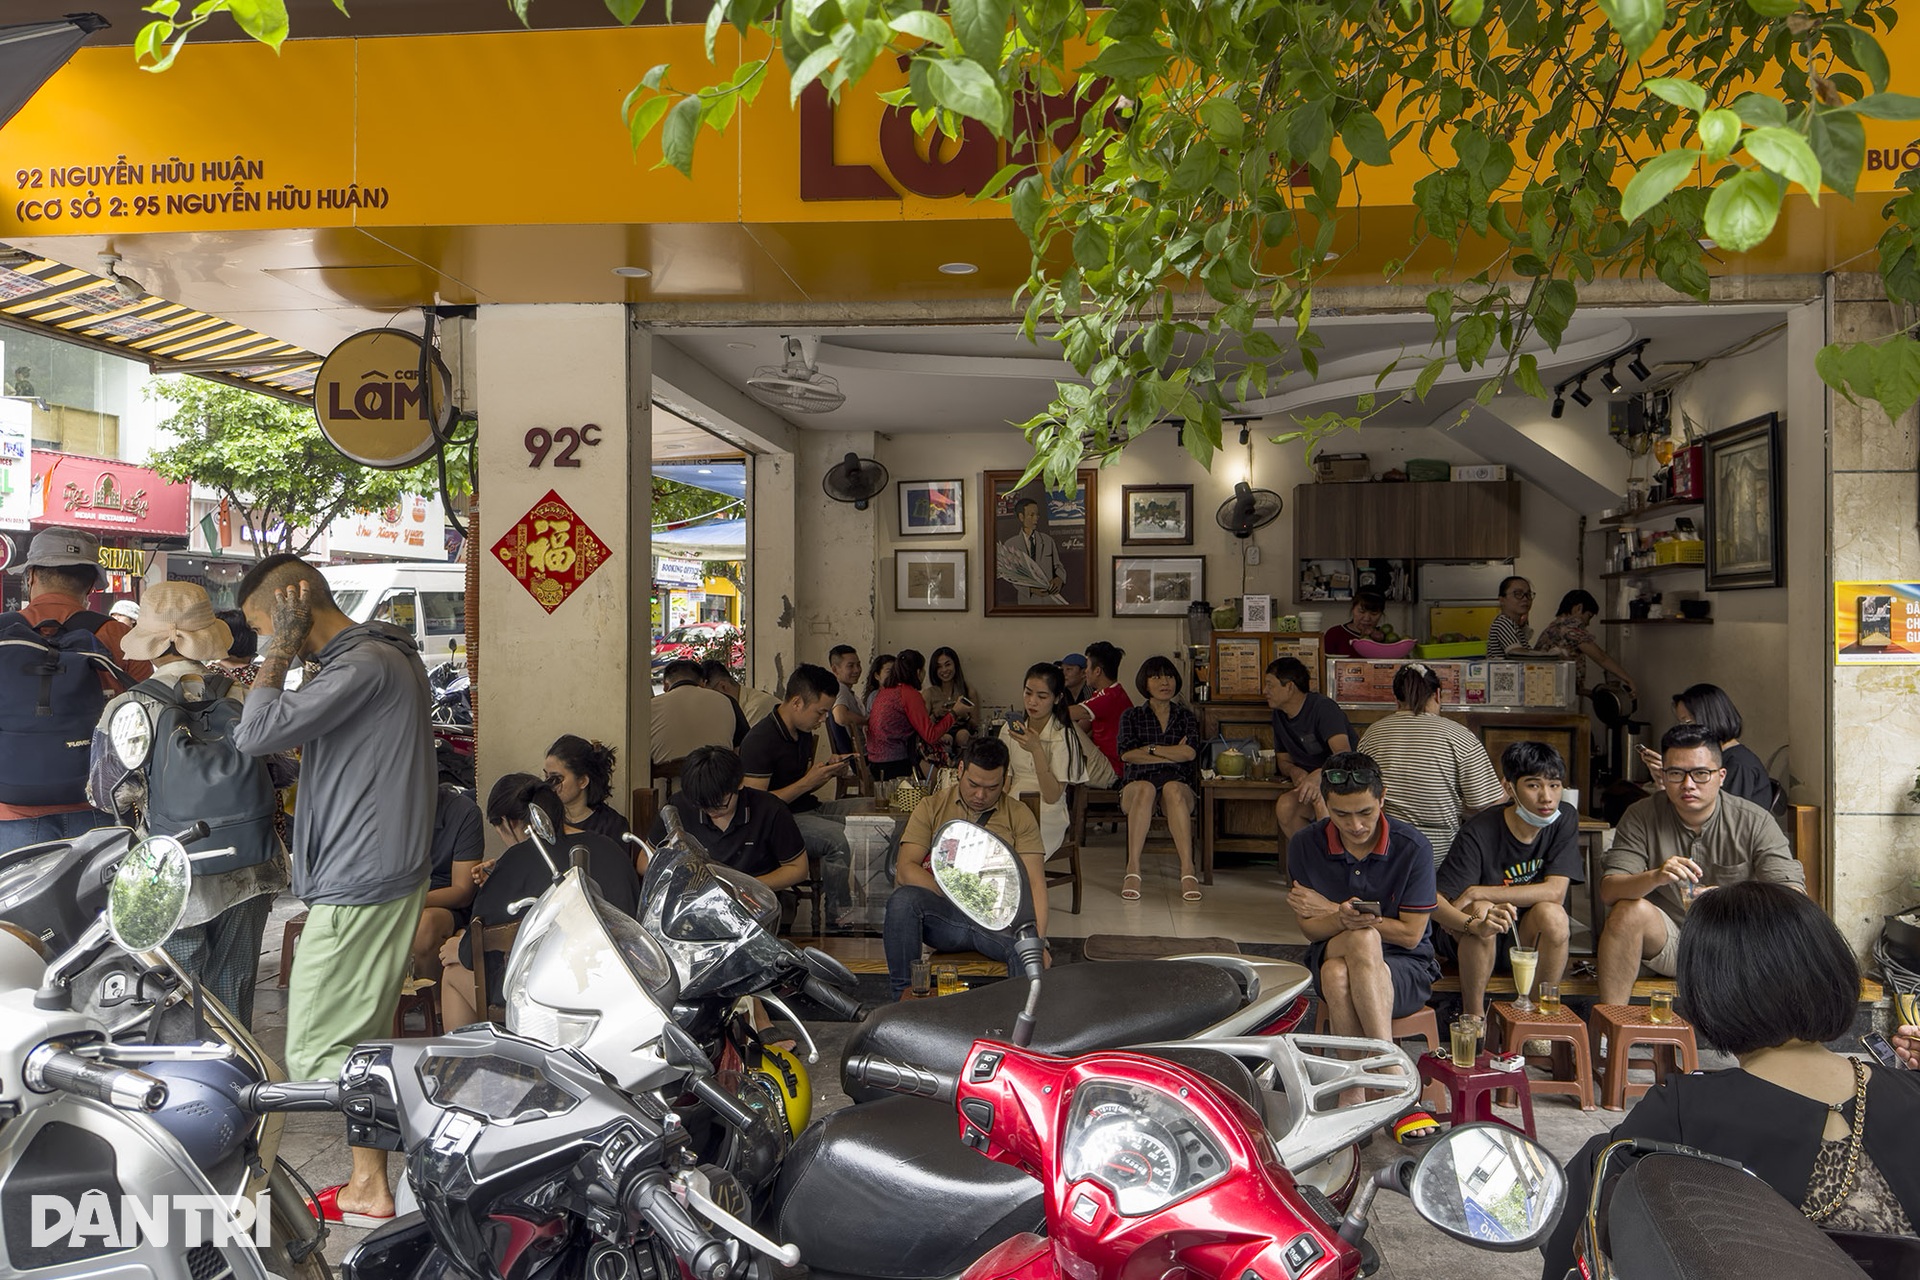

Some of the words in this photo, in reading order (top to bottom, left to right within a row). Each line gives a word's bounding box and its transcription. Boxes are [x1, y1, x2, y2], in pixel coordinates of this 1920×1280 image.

[16, 169, 43, 190] 92
[49, 155, 144, 187] NGUYỄN
[151, 157, 195, 184] HỮU
[201, 155, 264, 182] HUÂN
[16, 198, 63, 223] (CƠ
[70, 190, 101, 219] SỞ
[109, 196, 129, 217] 2:
[133, 196, 161, 216] 95
[166, 181, 261, 215] NGUYỄN
[267, 184, 311, 210] HỮU
[317, 183, 389, 210] HUÂN)
[74, 511, 96, 519] INDIAN
[98, 513, 137, 523] RESTAURANT
[526, 519, 576, 573] 福
